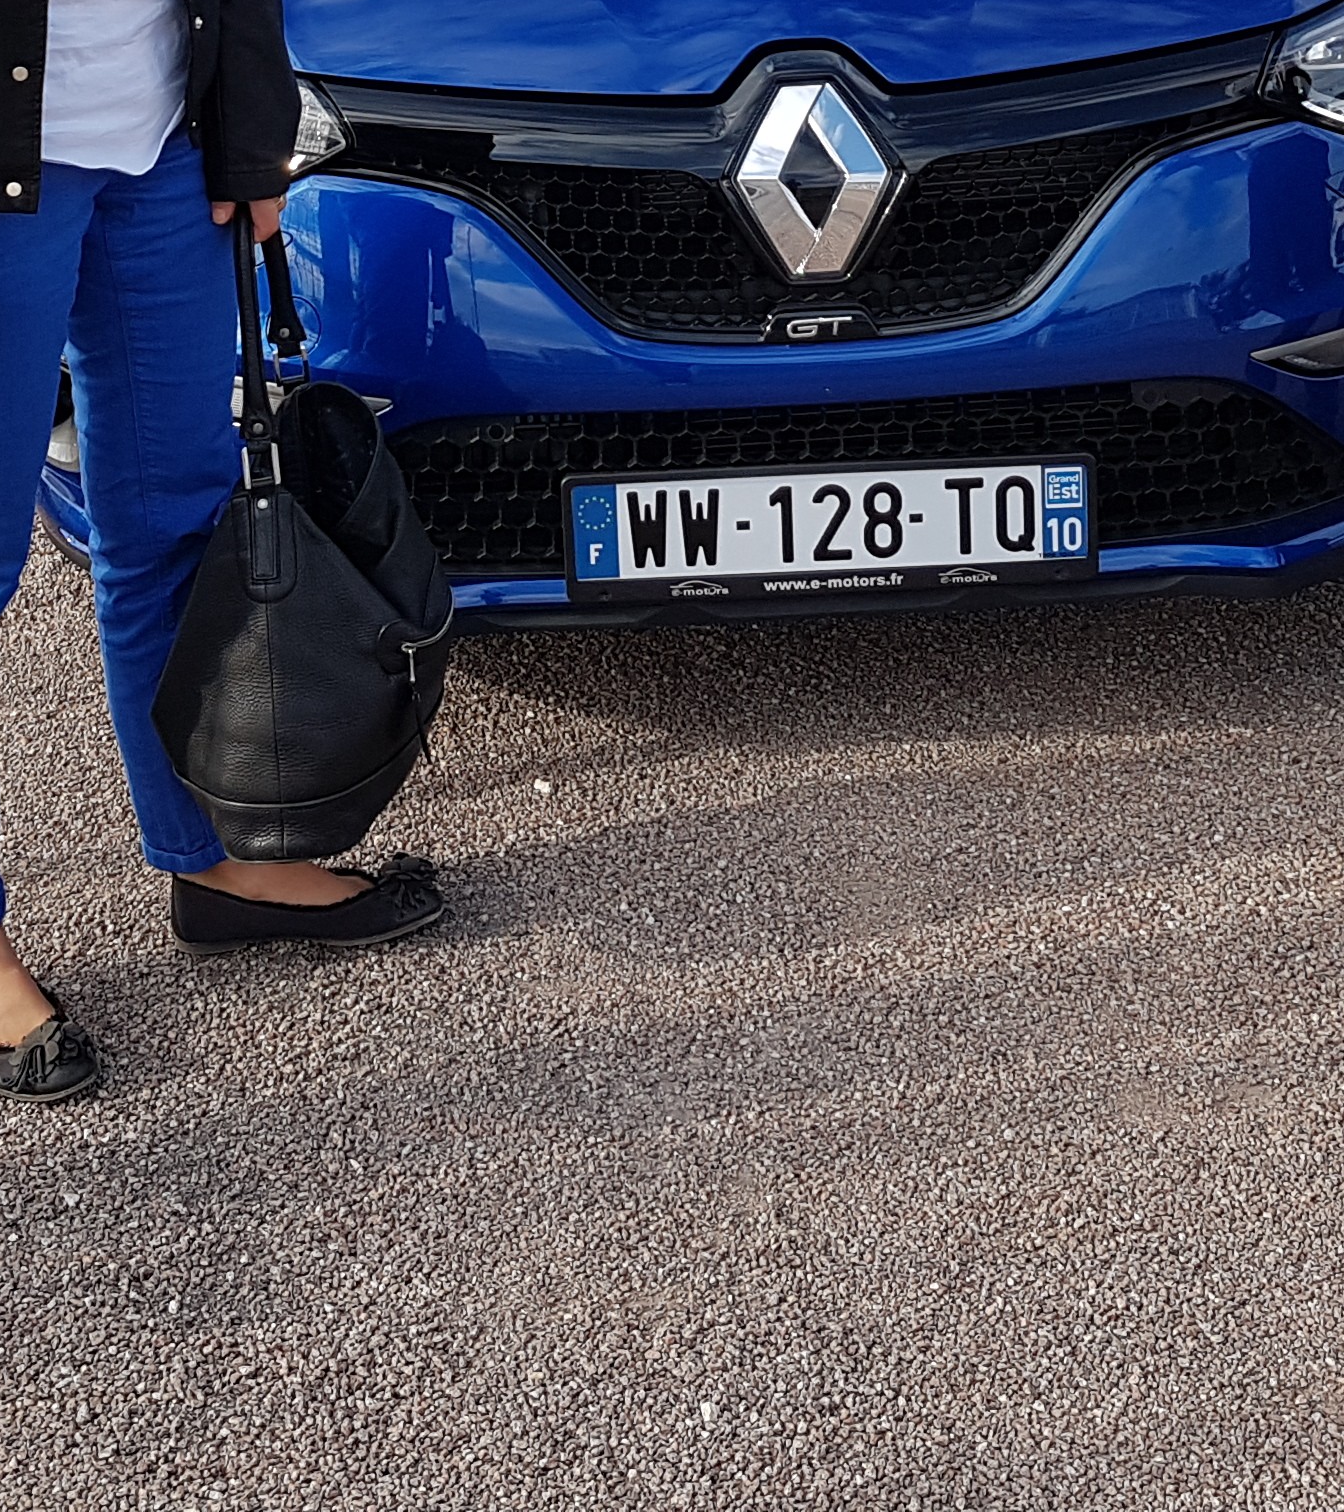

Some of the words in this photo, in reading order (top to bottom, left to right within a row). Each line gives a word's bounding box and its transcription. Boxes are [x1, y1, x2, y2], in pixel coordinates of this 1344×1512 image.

[787, 316, 852, 338] GT
[1048, 474, 1079, 483] Grand
[1048, 483, 1079, 499] Est
[626, 475, 1036, 569] WW-128-TQ
[1047, 517, 1082, 552] 10
[589, 543, 603, 566] F
[763, 573, 904, 591] www.e-motors.fr
